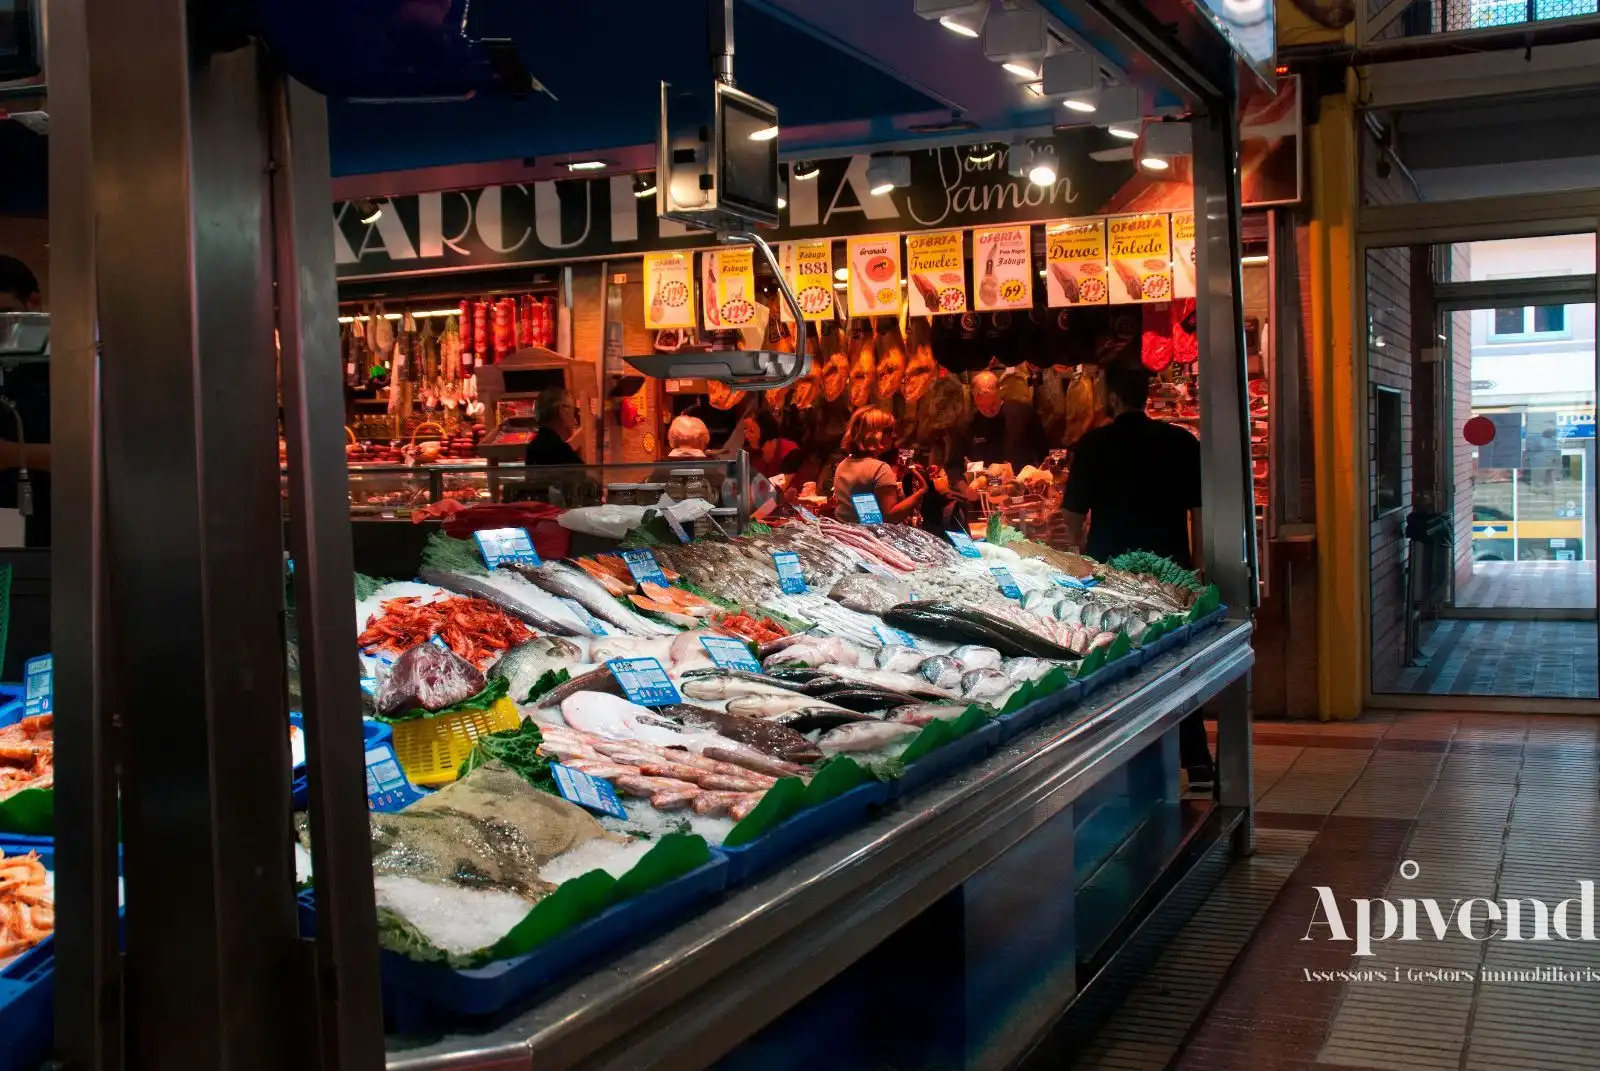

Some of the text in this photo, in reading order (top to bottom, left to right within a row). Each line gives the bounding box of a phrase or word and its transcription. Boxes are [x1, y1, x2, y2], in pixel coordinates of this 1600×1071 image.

[1111, 219, 1163, 233] OFERTA
[910, 235, 957, 249] OFERTA
[980, 230, 1022, 244] OFERTA
[1048, 245, 1100, 260] Duroc
[1110, 239, 1162, 256] Toledo
[799, 261, 829, 276] 1881
[996, 257, 1026, 267] Jabugo
